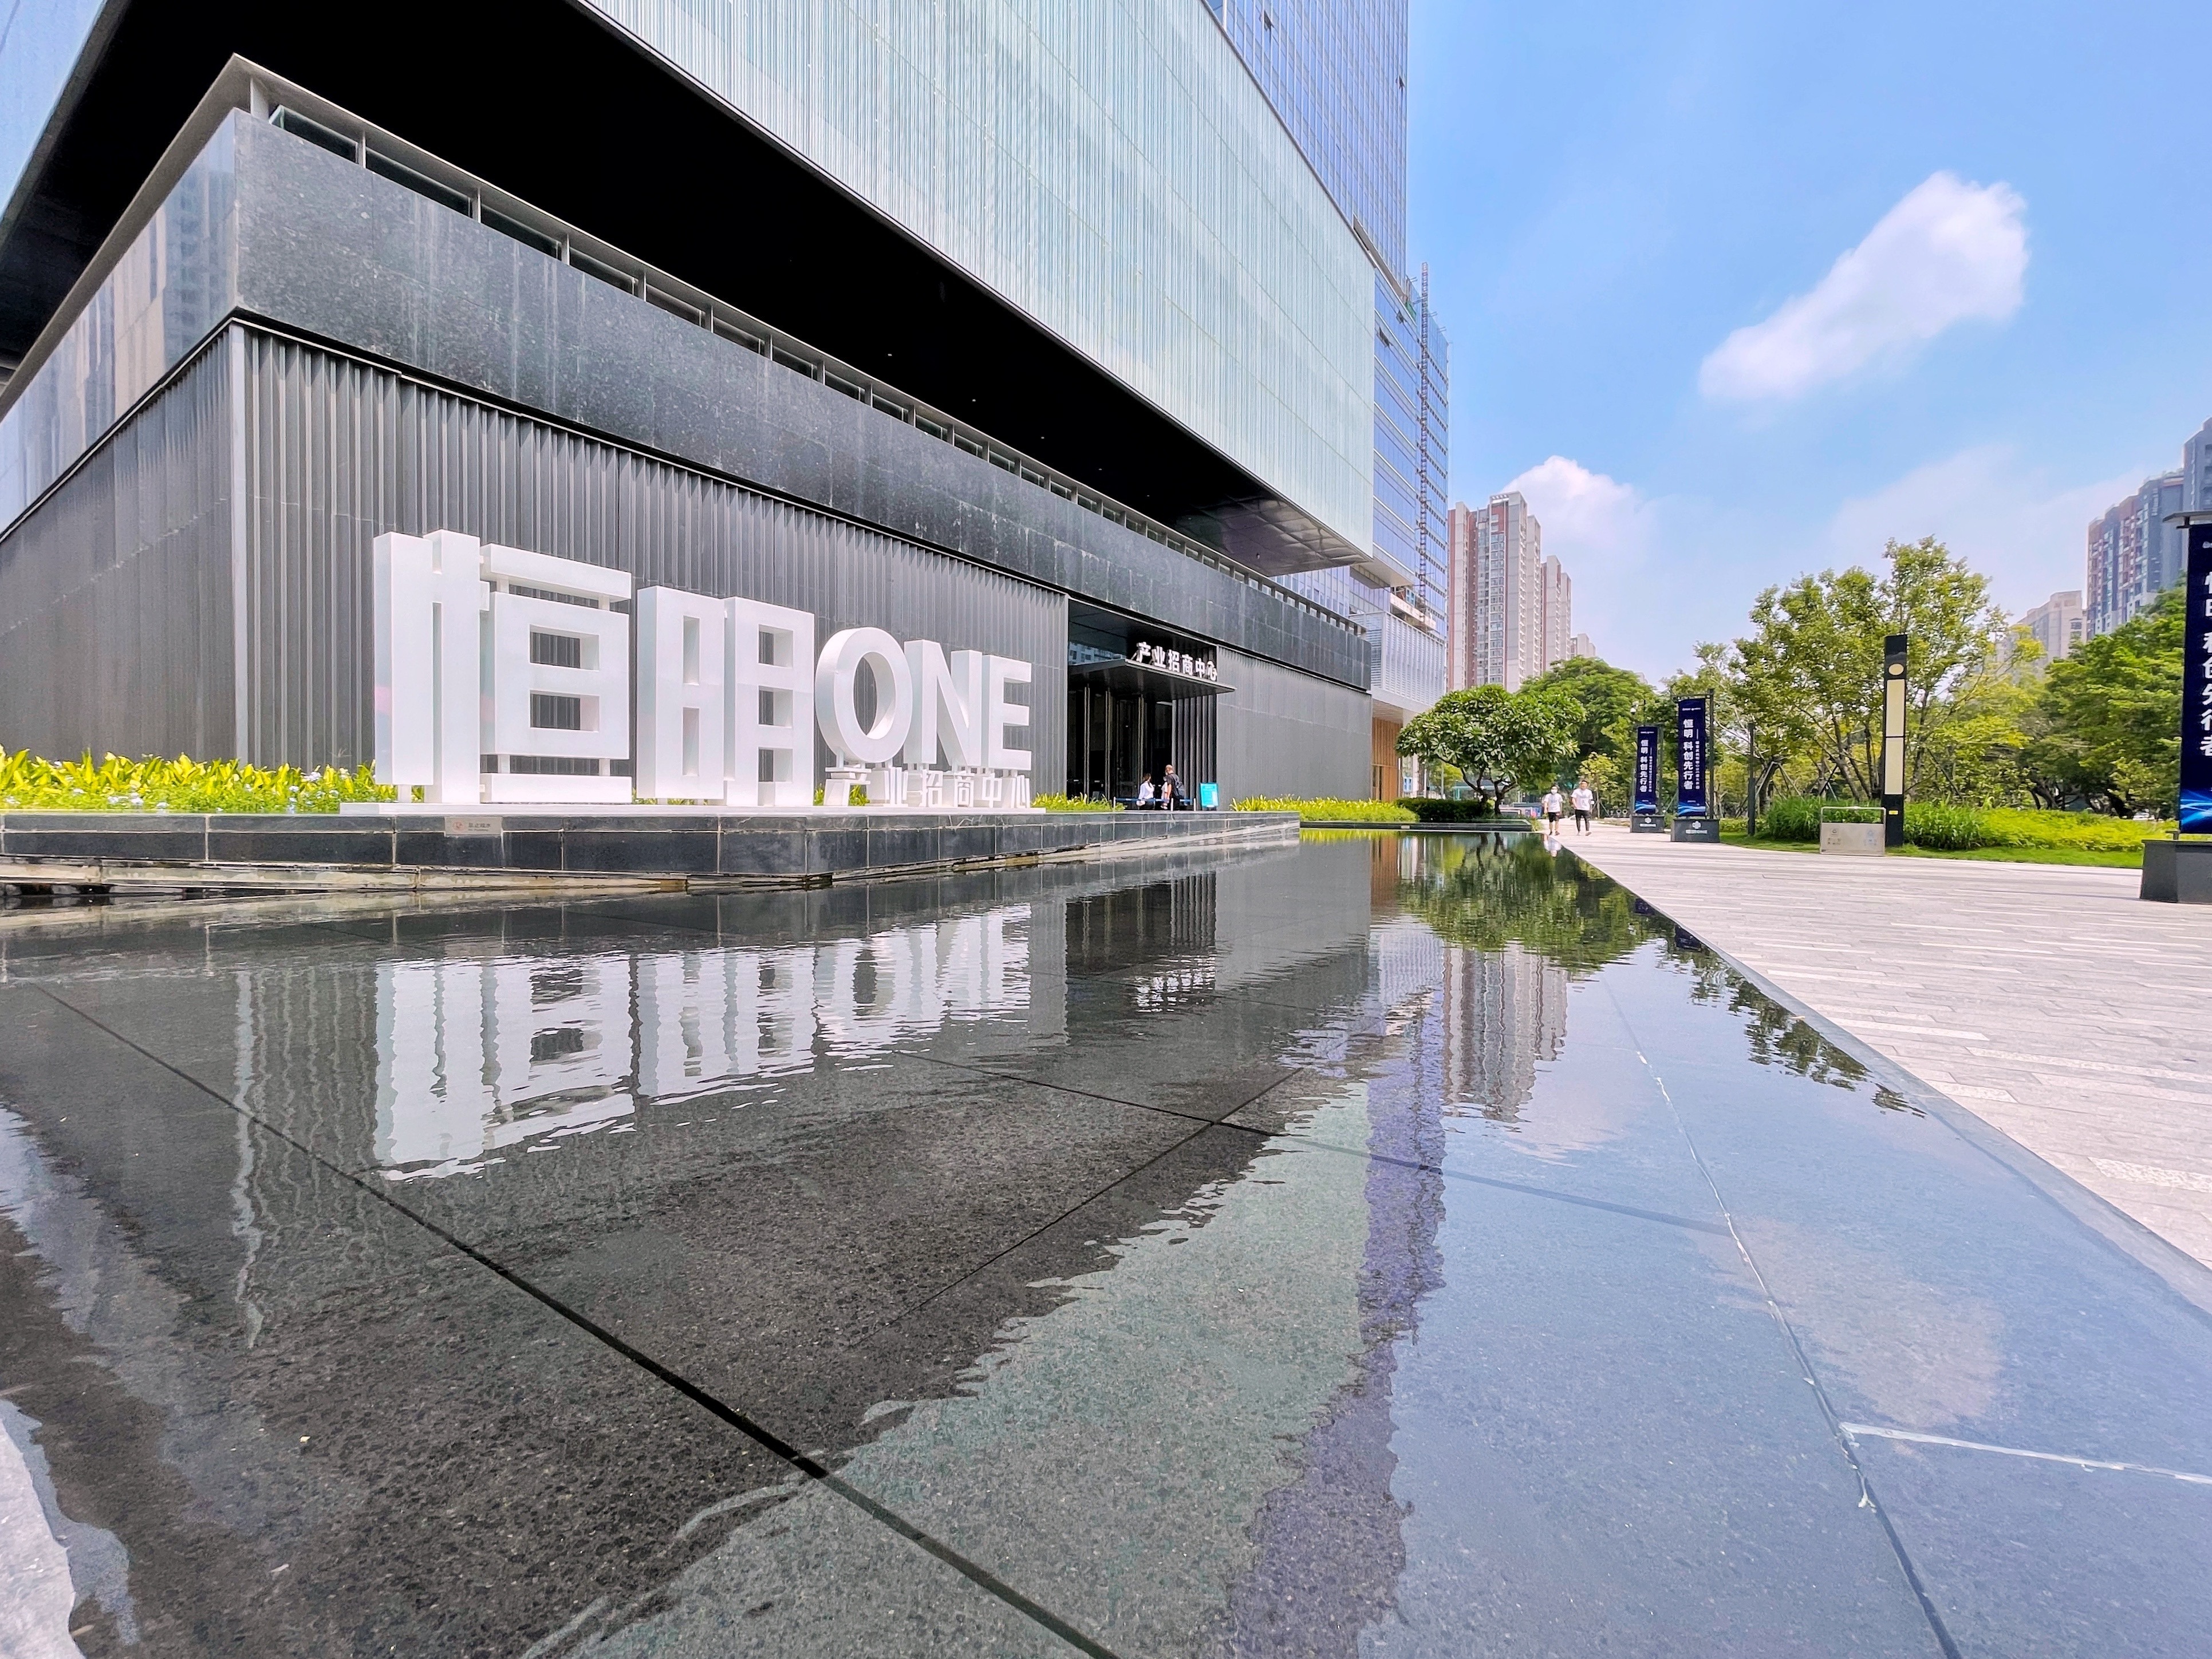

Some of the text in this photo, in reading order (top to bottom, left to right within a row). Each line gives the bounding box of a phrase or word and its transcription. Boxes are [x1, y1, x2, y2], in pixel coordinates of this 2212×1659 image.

[1136, 641, 1217, 681] 产业招商中心
